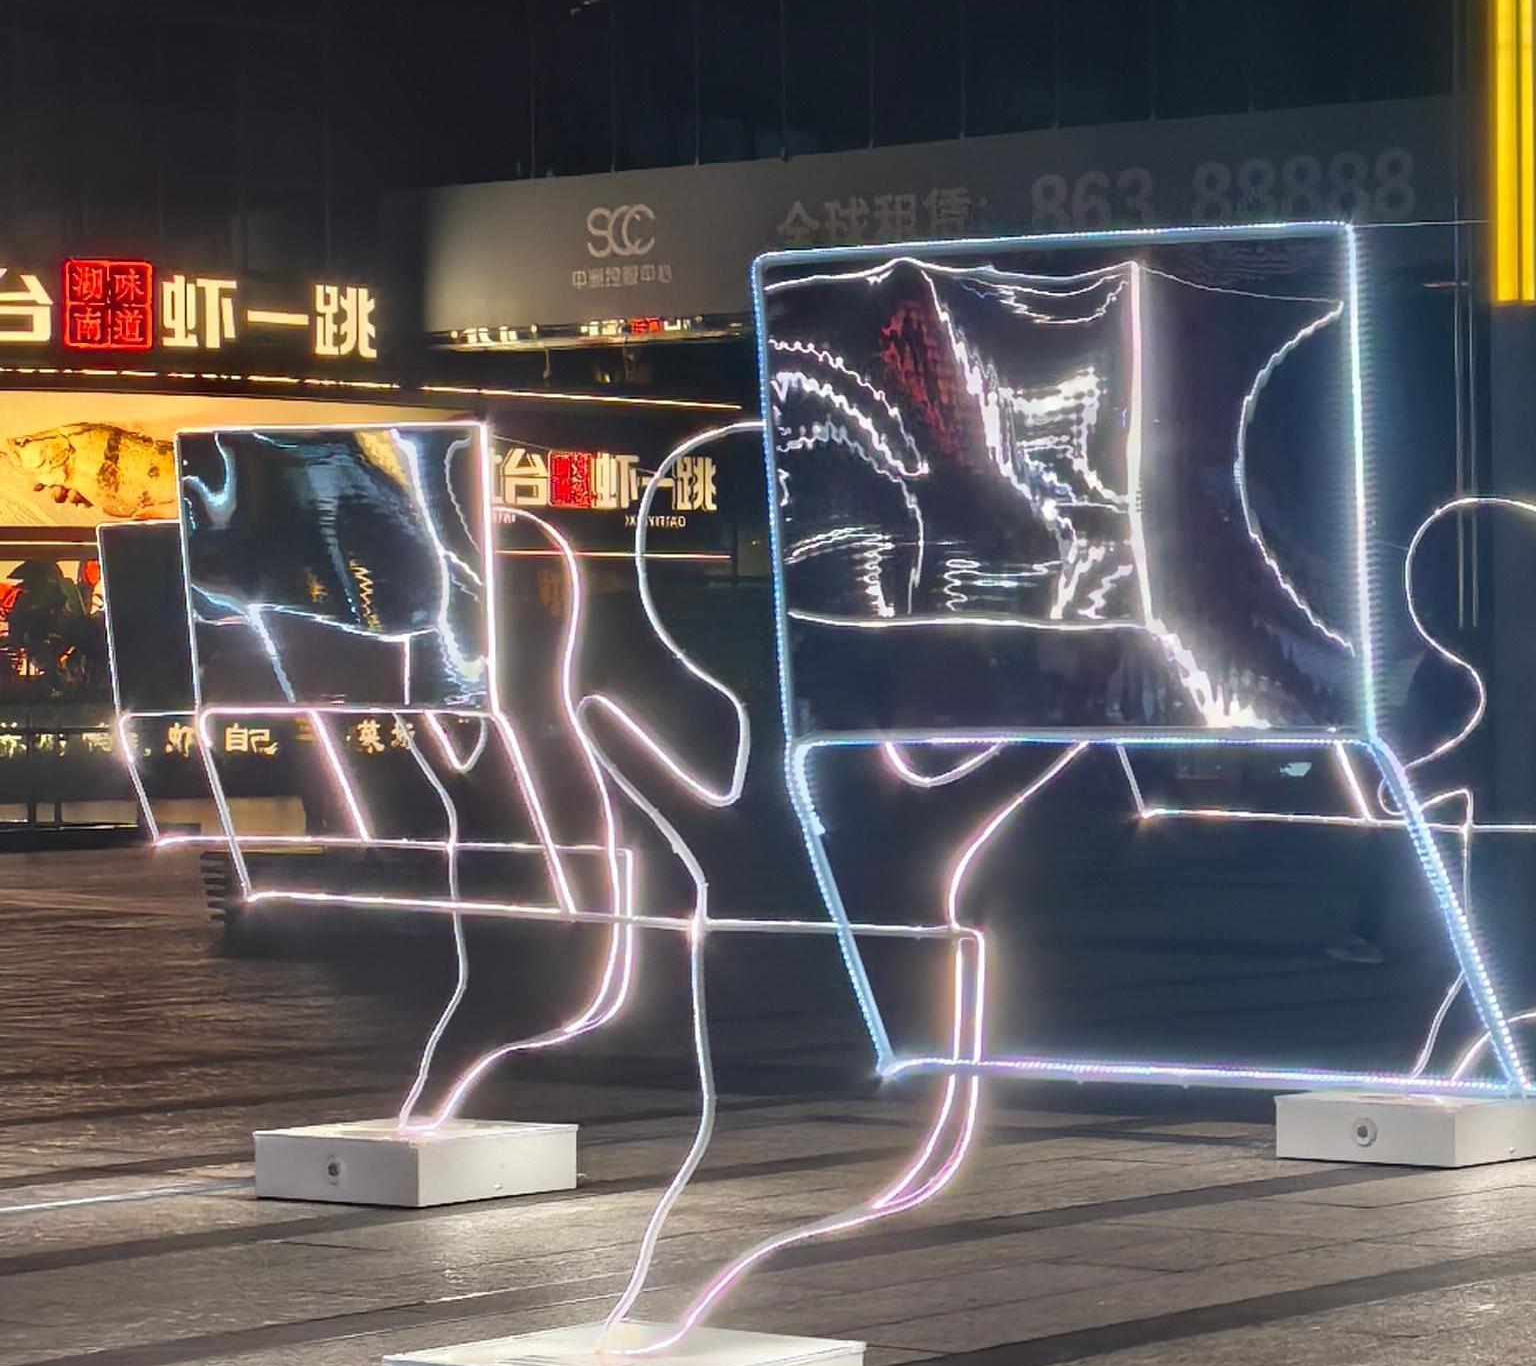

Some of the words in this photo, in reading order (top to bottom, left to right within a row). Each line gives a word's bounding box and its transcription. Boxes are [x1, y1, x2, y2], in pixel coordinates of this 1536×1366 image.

[1031, 167, 1152, 230] 863
[1192, 147, 1416, 225] 88888
[587, 204, 655, 258] SCC
[161, 274, 377, 359] 虾一跳
[589, 451, 718, 511] 虾一跳
